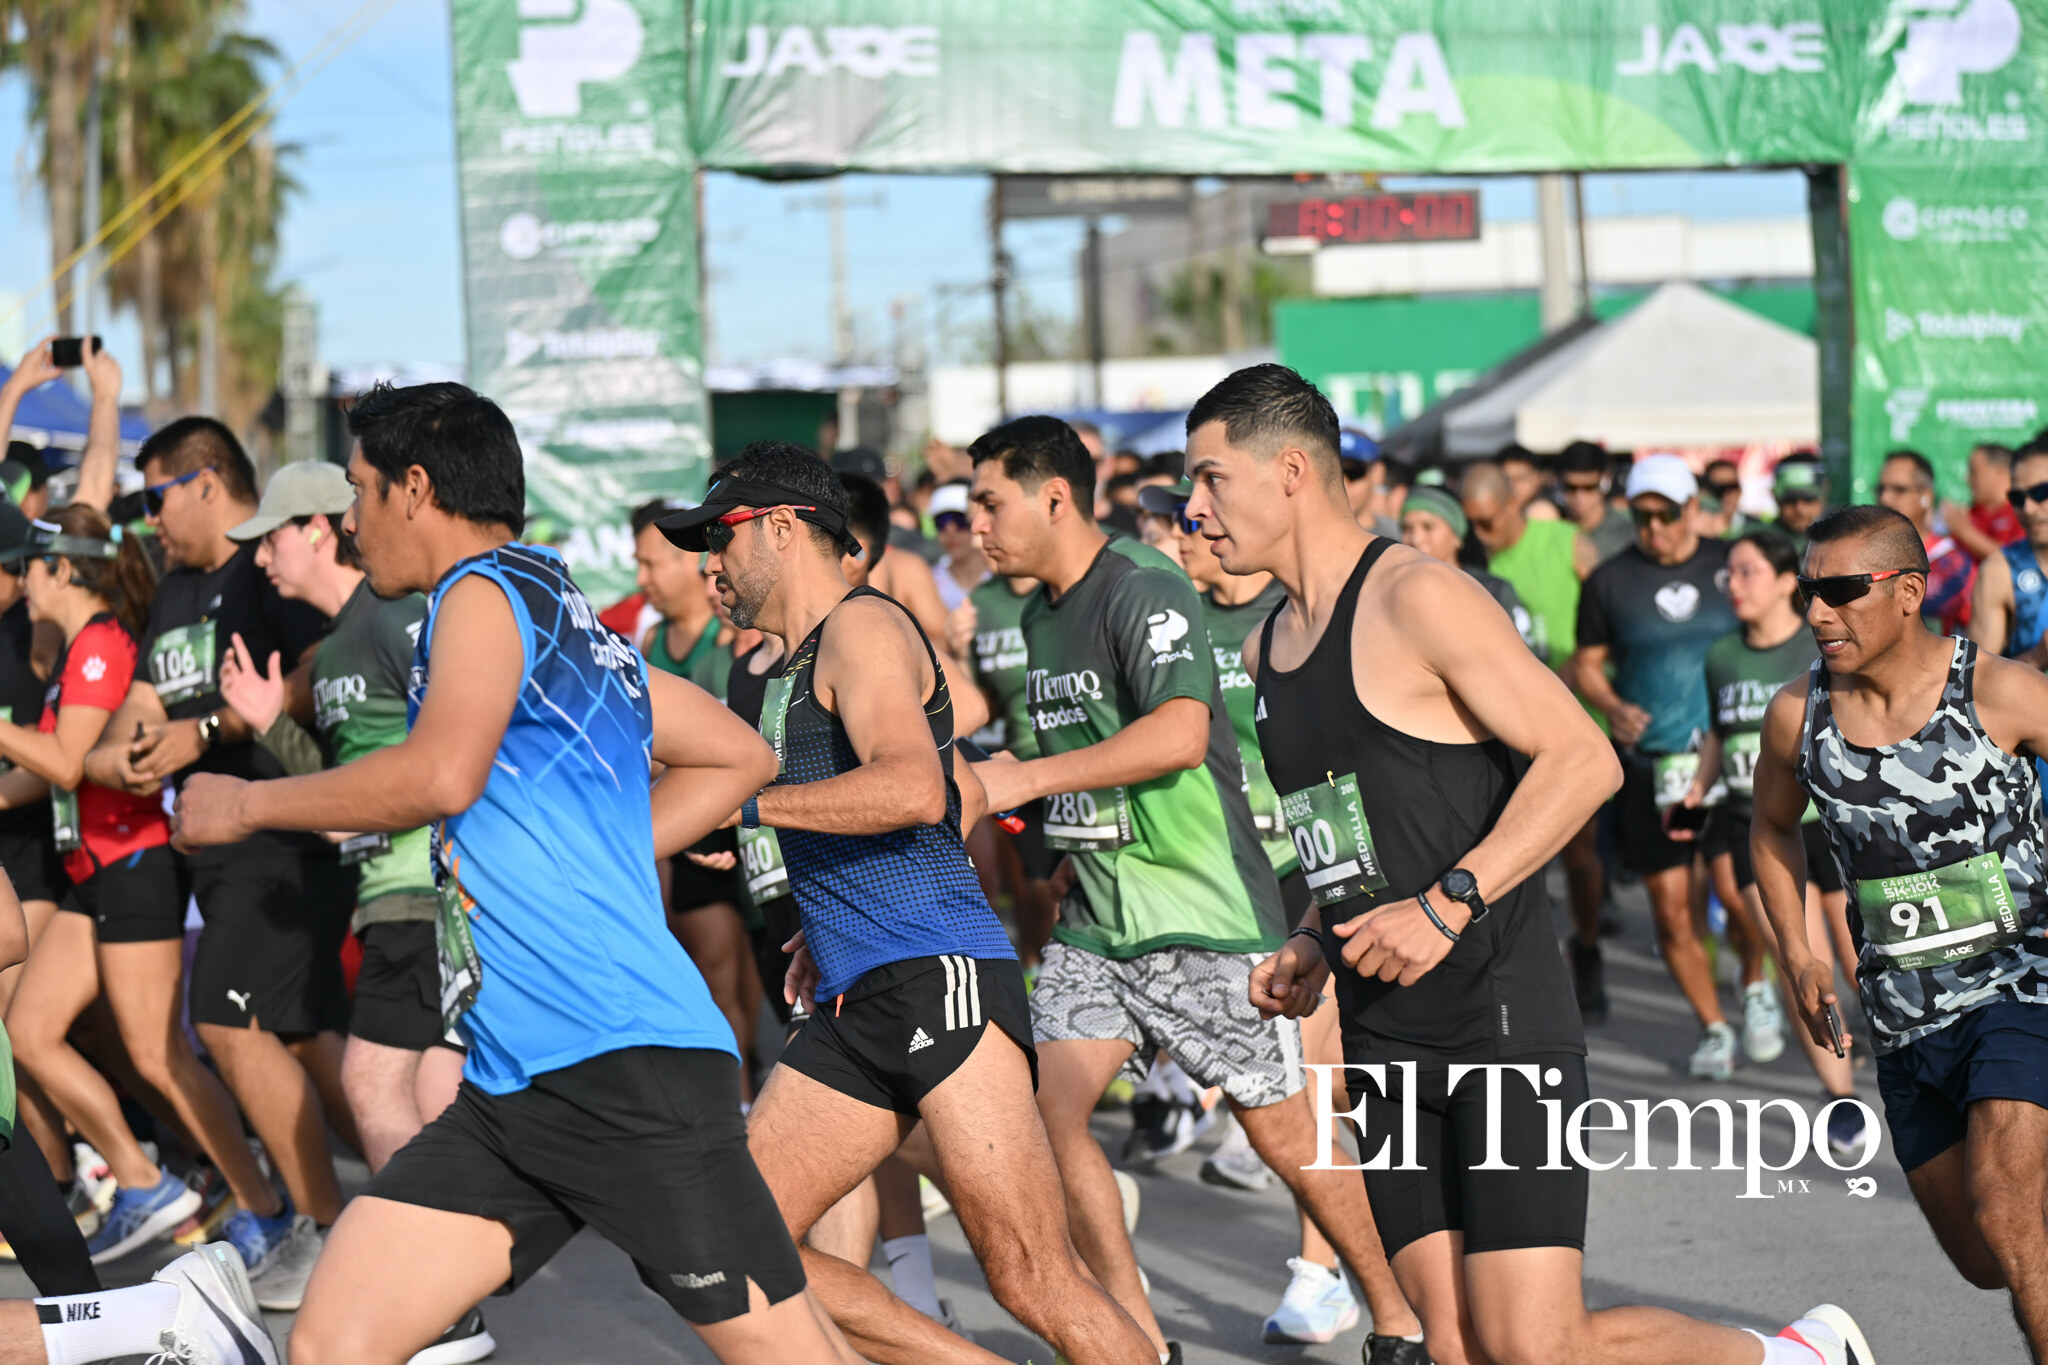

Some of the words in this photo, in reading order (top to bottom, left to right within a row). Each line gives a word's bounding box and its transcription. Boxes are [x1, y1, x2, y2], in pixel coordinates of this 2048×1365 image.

[1112, 31, 1468, 129] META
[155, 643, 197, 682] 106
[1031, 669, 1101, 705] Tiempo
[775, 695, 788, 761] MEDALLA
[1036, 706, 1088, 730] todos
[1047, 792, 1098, 826] 280
[1294, 819, 1337, 871] 00
[1347, 801, 1377, 876] MEDALLA
[1881, 873, 1937, 888] CARRERA
[1982, 860, 1993, 870] 91
[1890, 896, 1950, 939] 91
[1988, 874, 2018, 934] MEDALLA
[909, 1037, 935, 1054] adidas
[66, 1301, 101, 1322] NIKE
